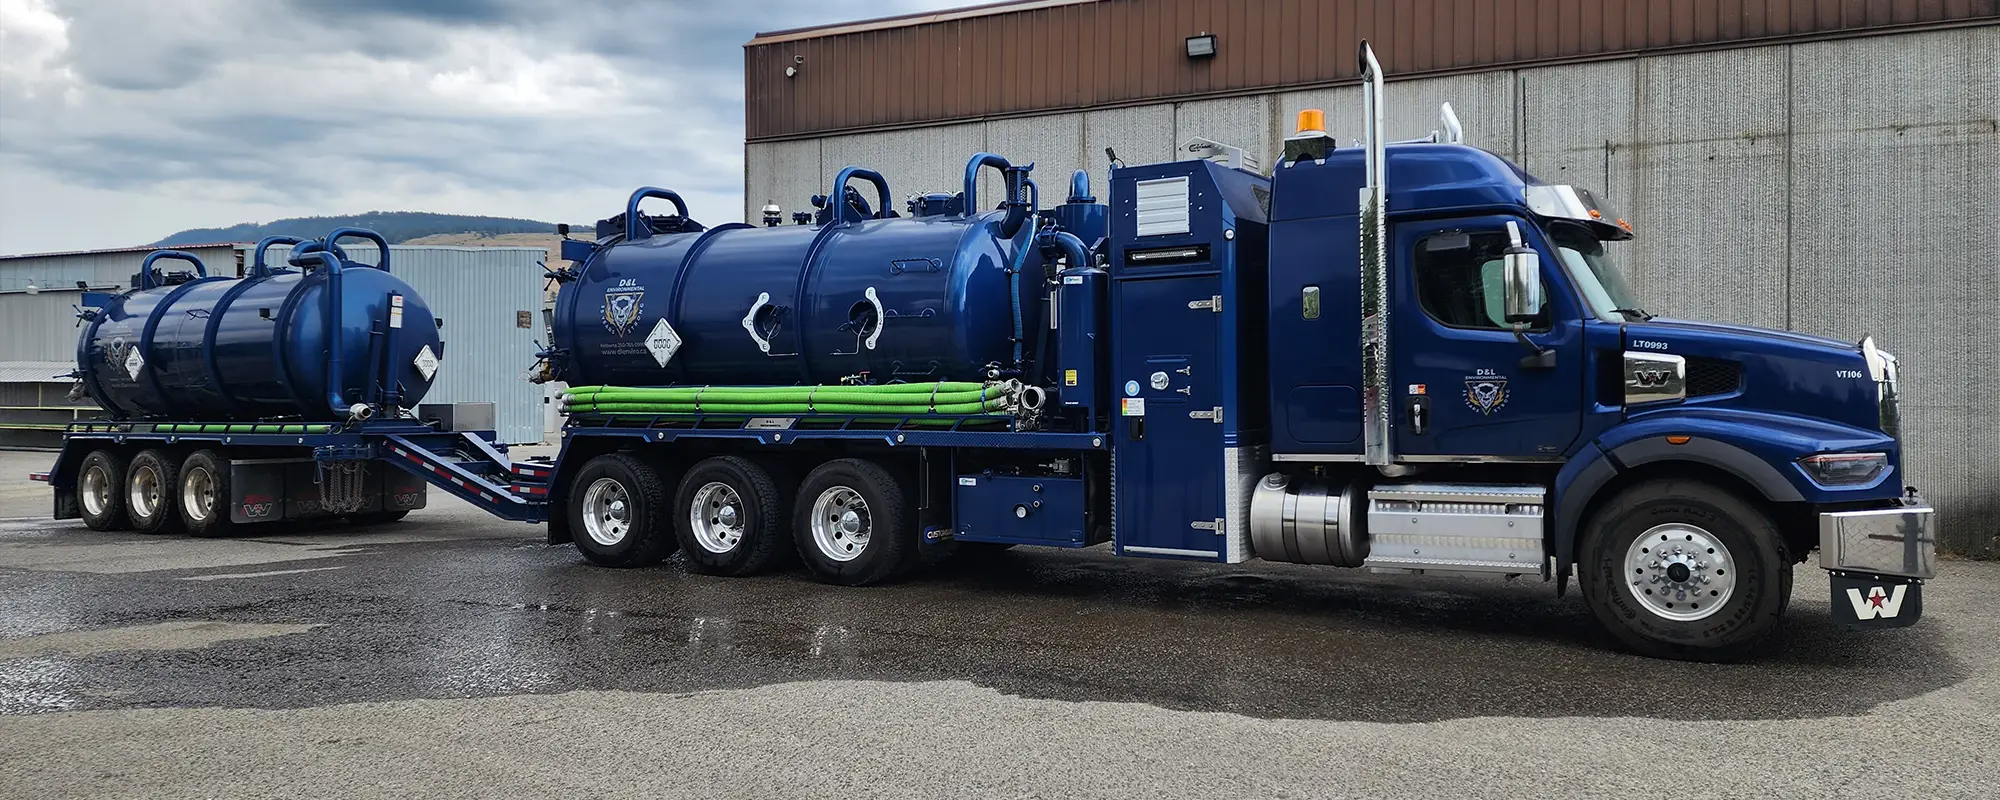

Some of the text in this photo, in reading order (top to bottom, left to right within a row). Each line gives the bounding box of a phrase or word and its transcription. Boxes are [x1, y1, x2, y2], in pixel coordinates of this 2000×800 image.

[619, 279, 636, 287] D&L
[627, 302, 645, 334] STRONG
[762, 342, 768, 350] E
[1632, 339, 1669, 350] LT0993
[1476, 368, 1496, 376] D&L
[1836, 370, 1863, 379] VT106
[1493, 388, 1511, 413] STRONG
[1846, 584, 1908, 620] W
